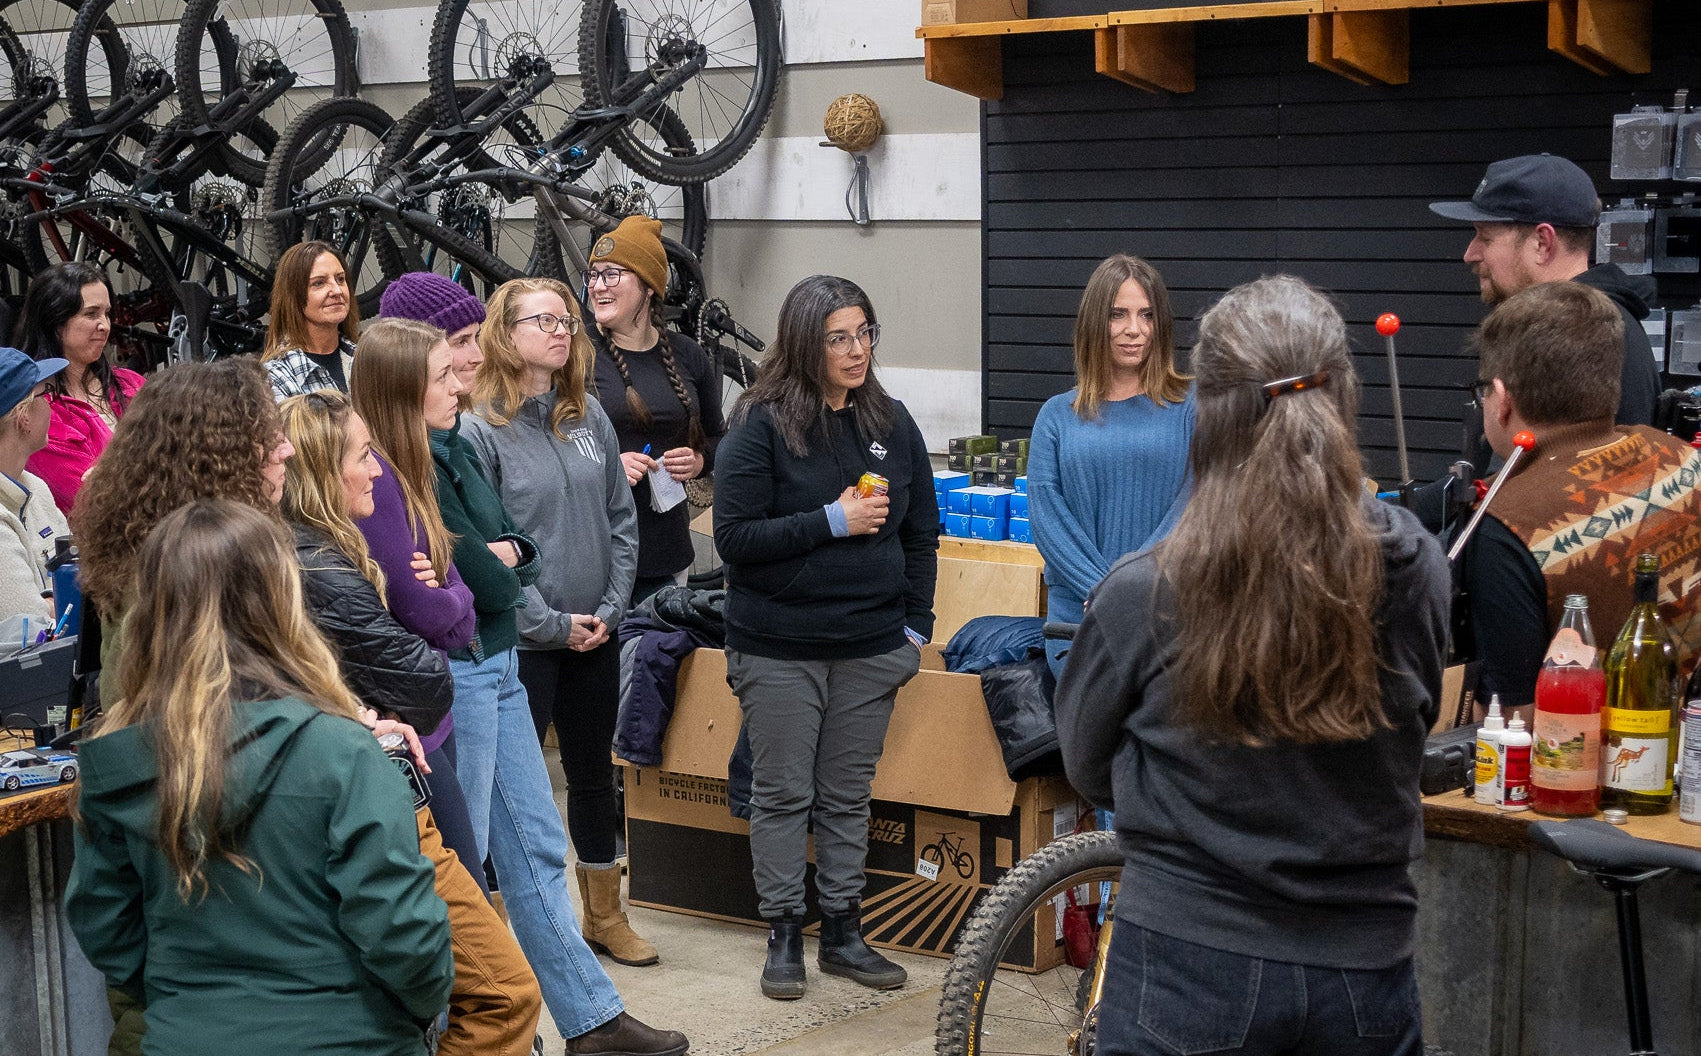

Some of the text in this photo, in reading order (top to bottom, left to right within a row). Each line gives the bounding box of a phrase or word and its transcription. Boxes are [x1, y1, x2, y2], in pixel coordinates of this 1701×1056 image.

[516, 120, 540, 148] MAXX
[659, 777, 729, 794] BICYCLE FACTO
[659, 788, 730, 807] IN CALIFORN
[867, 817, 906, 833] ANTA
[968, 1020, 976, 1056] RGOTAL
